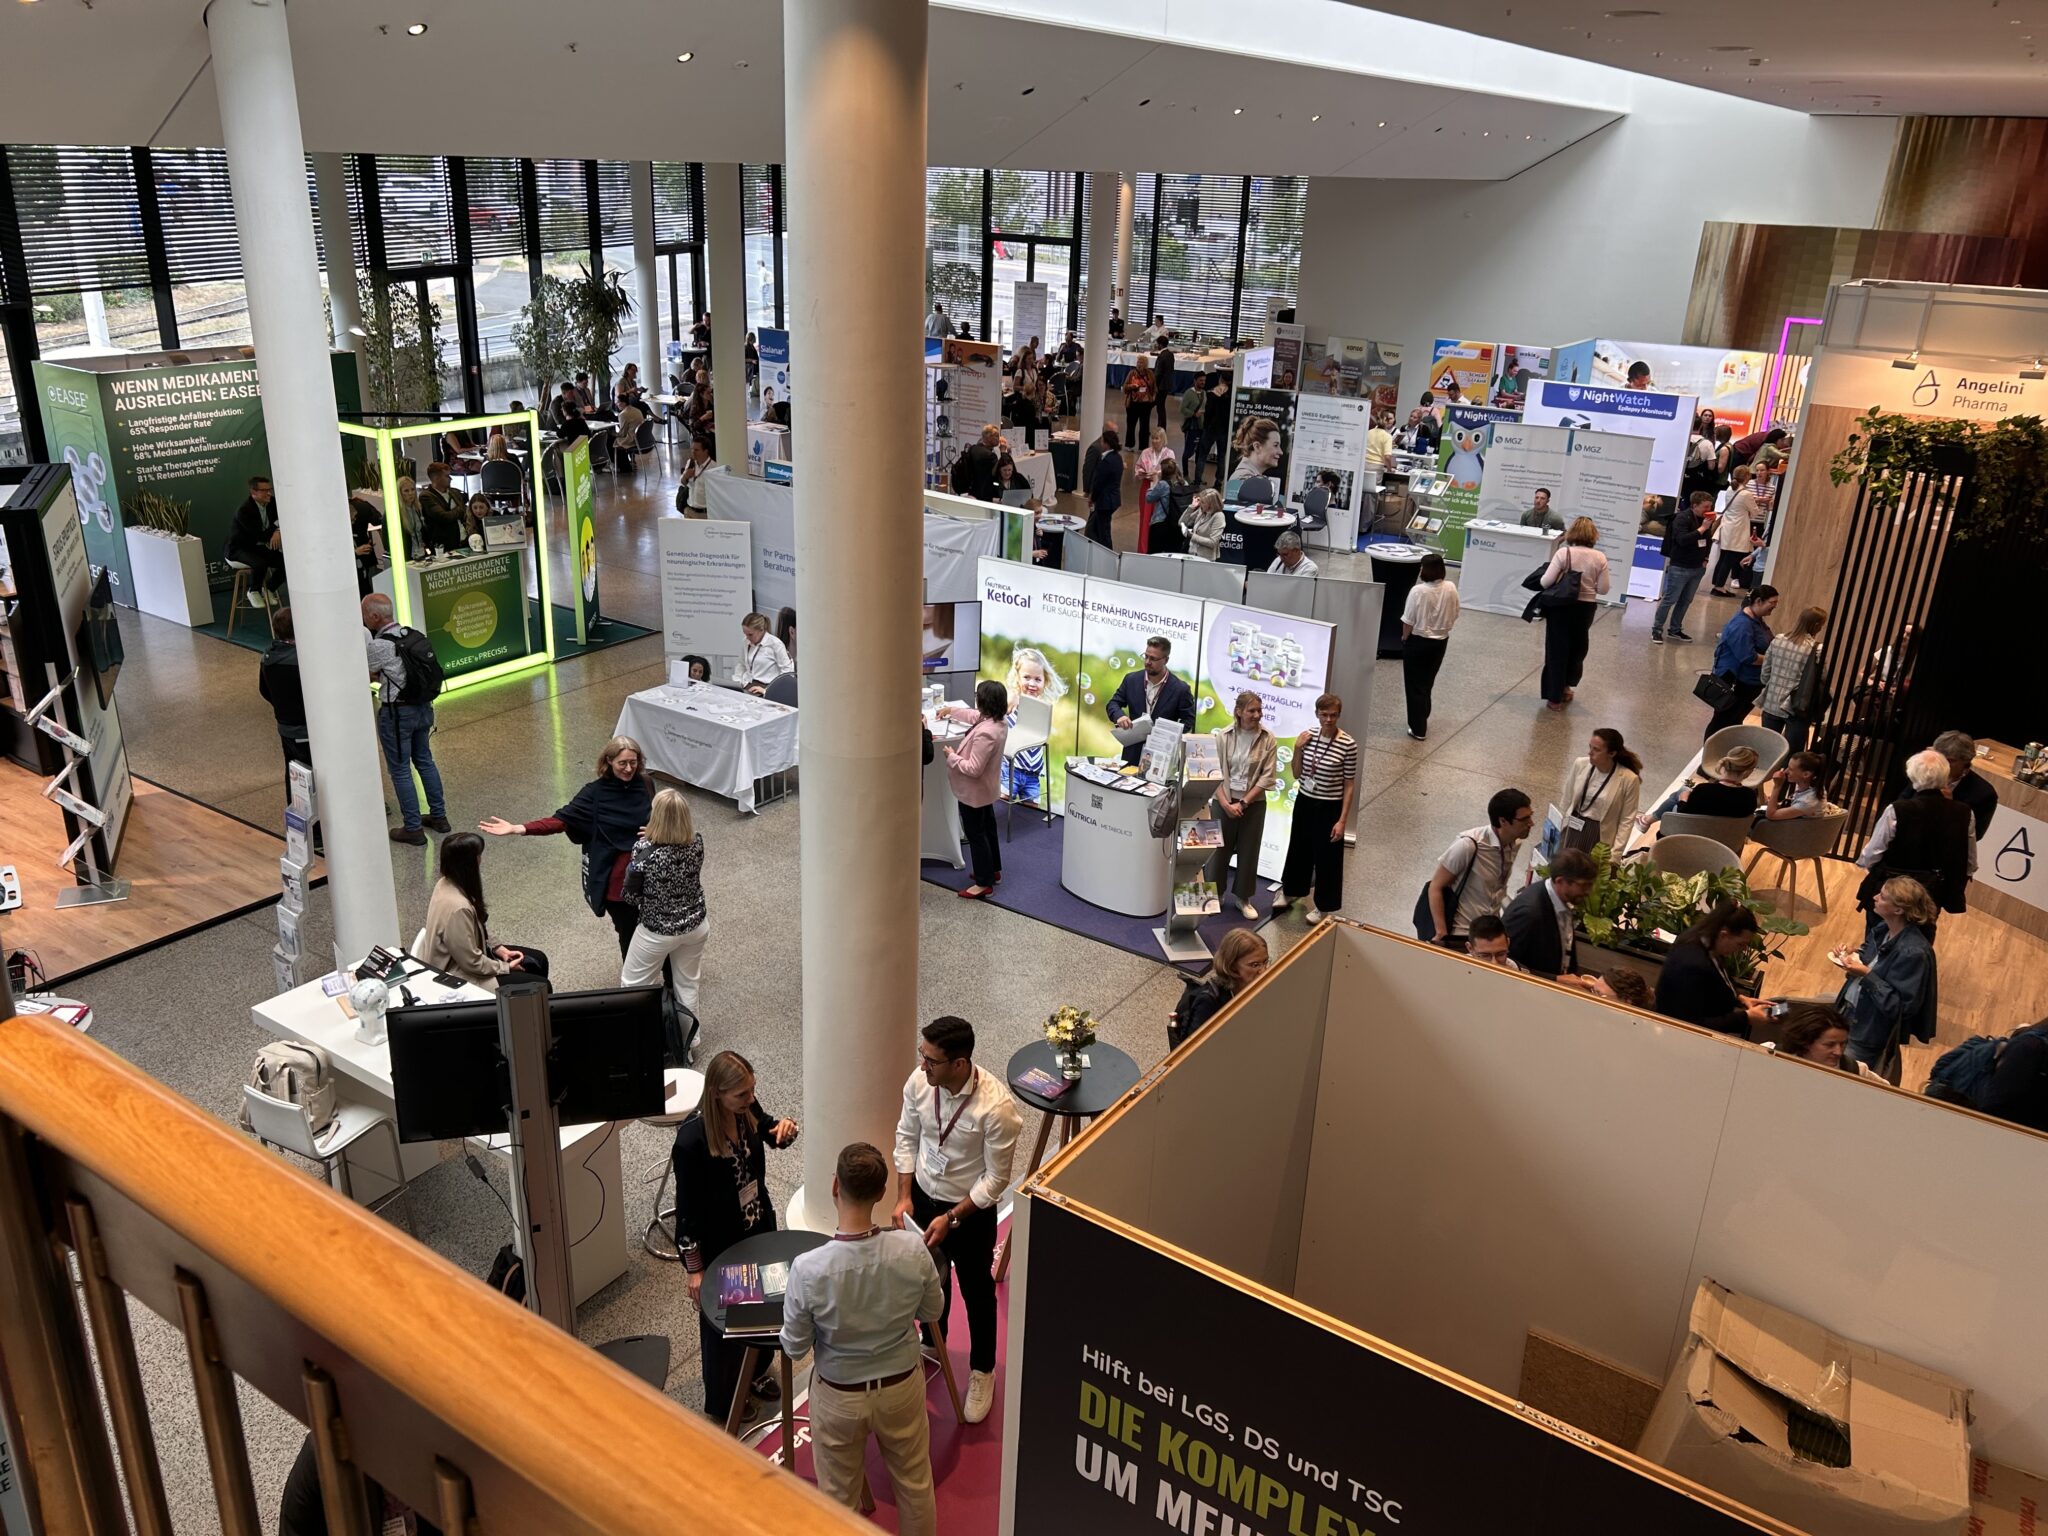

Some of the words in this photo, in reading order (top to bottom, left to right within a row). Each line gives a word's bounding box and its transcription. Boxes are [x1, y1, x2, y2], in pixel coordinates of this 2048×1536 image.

[111, 378, 158, 394] WENN
[162, 370, 259, 390] MEDIKAMENT
[1957, 378, 2025, 394] Angelini
[115, 389, 216, 411] AUSREICHEN:
[1583, 390, 1651, 406] NightWatch
[1952, 395, 2008, 412] Pharma
[1464, 410, 1514, 422] NightWatch
[1618, 404, 1641, 413] Epilepsy
[1642, 407, 1672, 417] Monitoring
[128, 414, 178, 428] Langfristige
[130, 426, 148, 436] 65%
[150, 422, 192, 434] Responder
[132, 442, 154, 452] Hohe
[134, 450, 152, 460] 68%
[153, 445, 185, 458] Mediane
[1584, 445, 1602, 454] MGZ
[136, 464, 162, 475] Starke
[137, 474, 155, 482] 81%
[156, 468, 194, 481] Retention
[1220, 533, 1244, 542] NEEG
[1220, 540, 1244, 550] edical
[763, 548, 772, 556] Ihr
[426, 570, 450, 582] WENN
[452, 556, 510, 577] MEDIKAMENTE
[428, 577, 454, 590] NICHT
[986, 588, 1031, 609] KetoCal
[1042, 592, 1090, 610] KETOGENE
[1092, 602, 1200, 632] ERNÄHRUNGSTHERAPIE
[1042, 604, 1056, 614] FÜR
[1101, 616, 1127, 629] KINDER
[1129, 622, 1134, 630] &
[1136, 623, 1188, 641] ERWACHSENE
[478, 646, 508, 660] PRECISIS
[1070, 808, 1097, 826] NUTRICIA
[1079, 1380, 1145, 1452] DIE
[1082, 1344, 1131, 1385] Hilft
[1138, 1371, 1174, 1407] bei
[1181, 1394, 1235, 1442] LGS,
[1243, 1426, 1280, 1460] DS
[1287, 1452, 1340, 1492] und
[1347, 1478, 1403, 1524] TSC
[1075, 1434, 1139, 1505] UM
